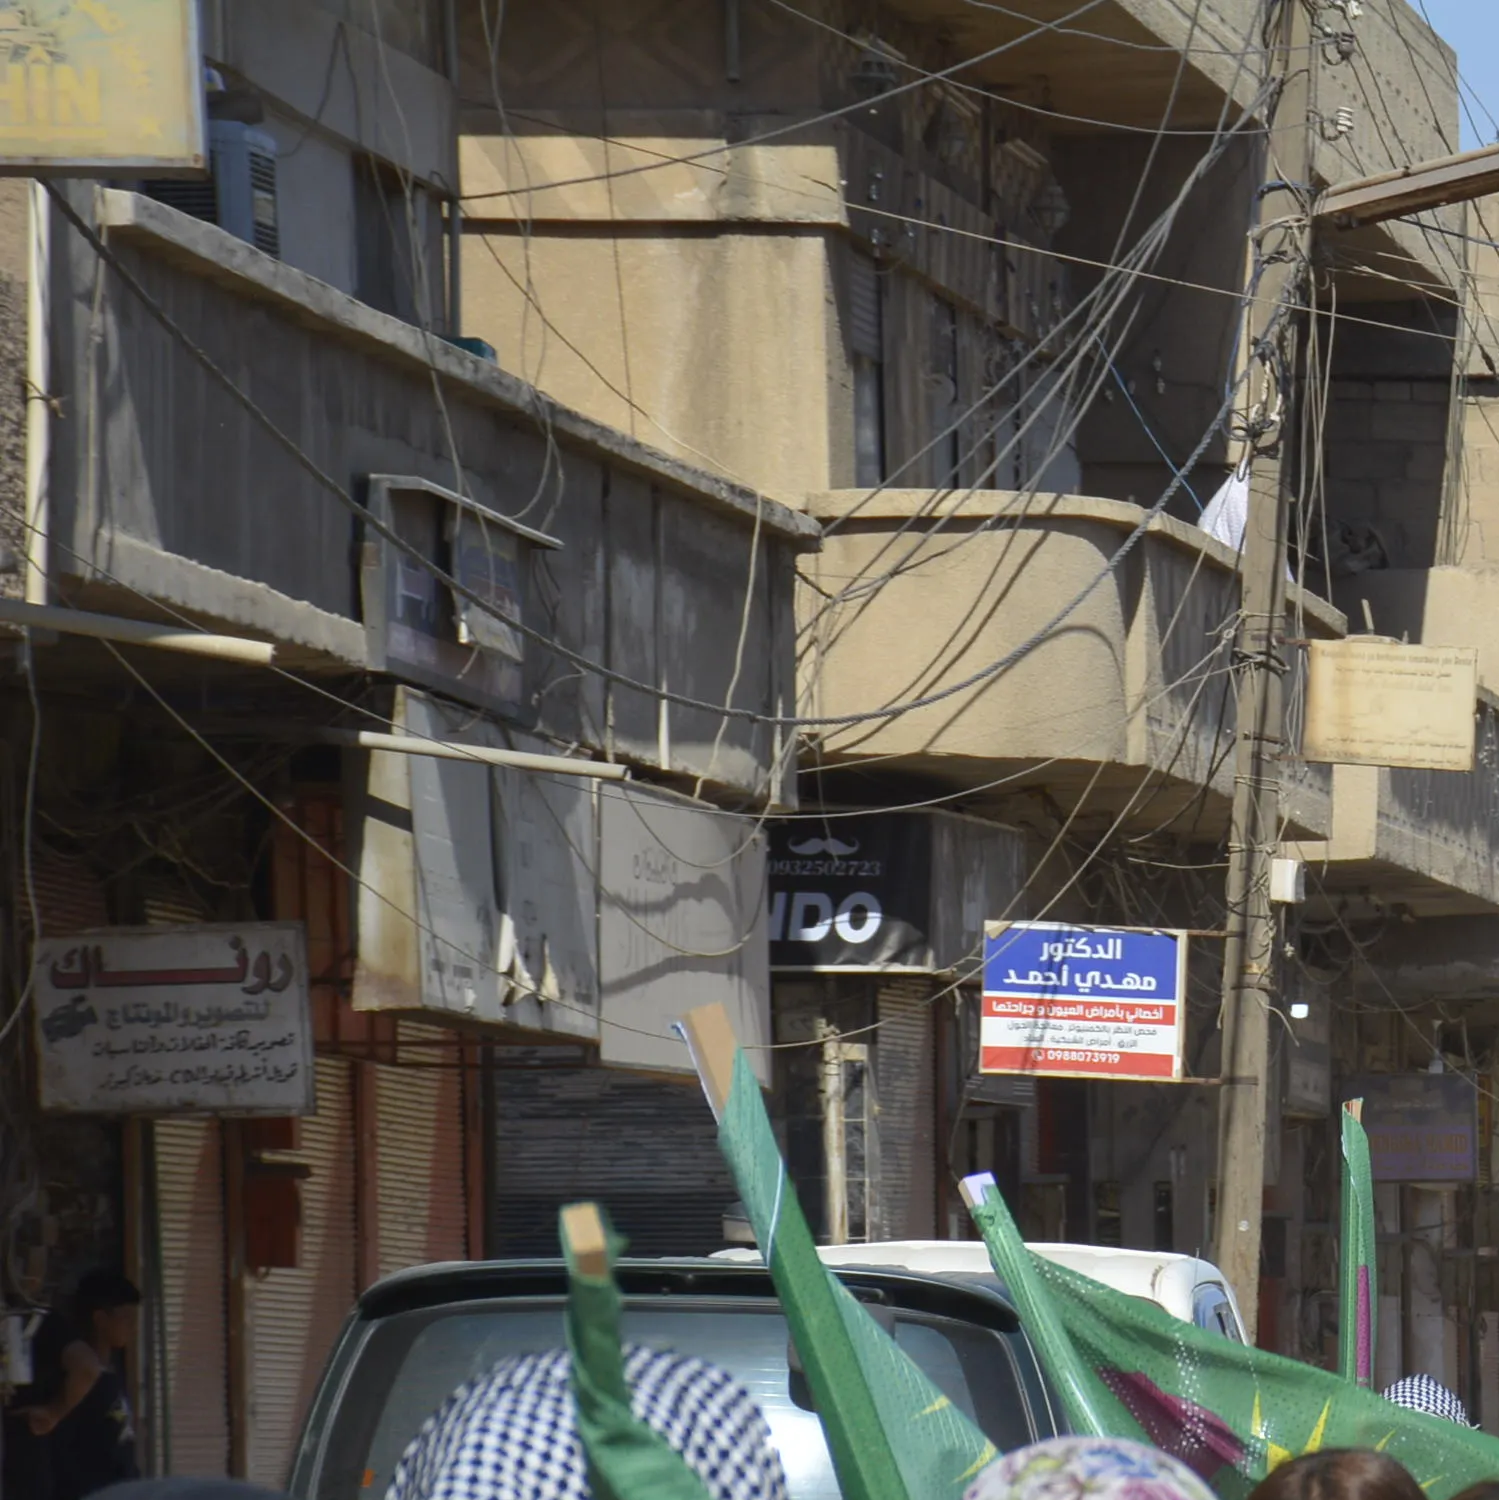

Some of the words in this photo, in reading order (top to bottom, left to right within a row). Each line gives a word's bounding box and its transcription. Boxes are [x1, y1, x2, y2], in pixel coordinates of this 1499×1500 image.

[1039, 937, 1122, 963] الدكتور
[1003, 965, 1069, 987] أحمد
[1074, 970, 1157, 993] مهدي
[1086, 1004, 1124, 1020] بأمراض
